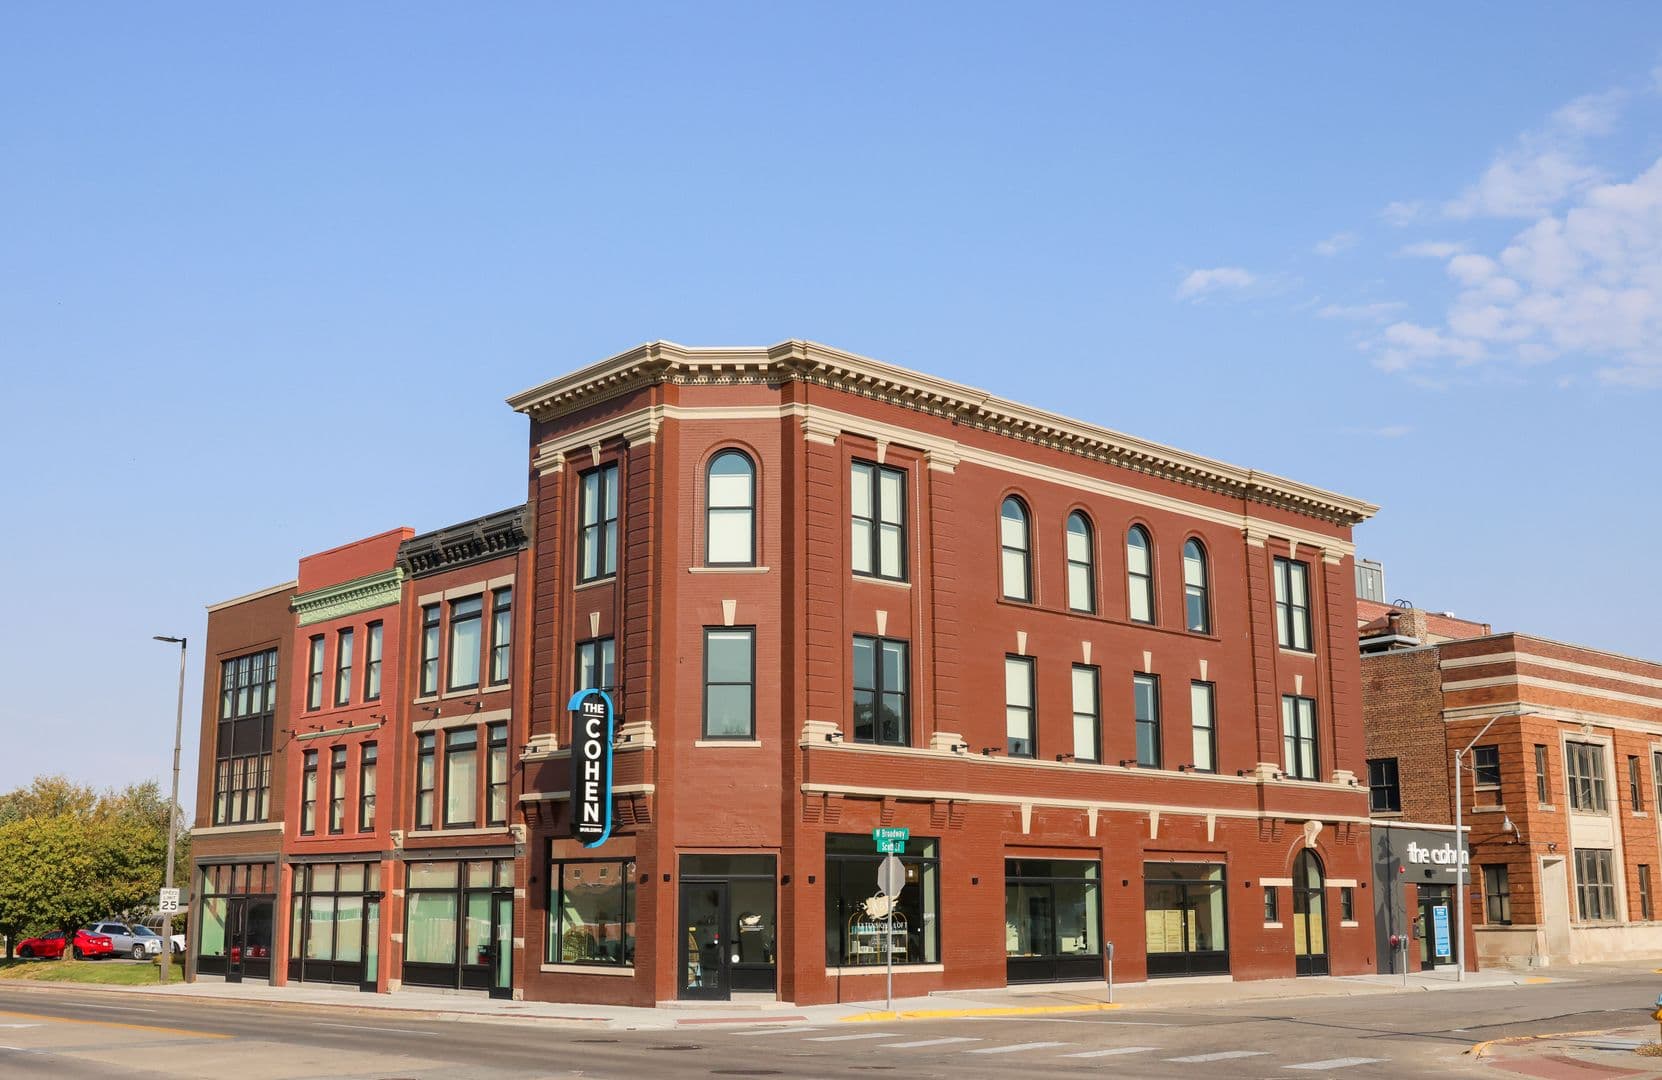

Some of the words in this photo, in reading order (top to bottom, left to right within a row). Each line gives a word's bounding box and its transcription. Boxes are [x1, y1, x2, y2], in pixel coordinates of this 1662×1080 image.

[583, 702, 605, 714] THE
[584, 718, 601, 822] COHEN
[881, 828, 906, 840] Broadway
[1407, 841, 1430, 863] the
[162, 901, 177, 910] 25
